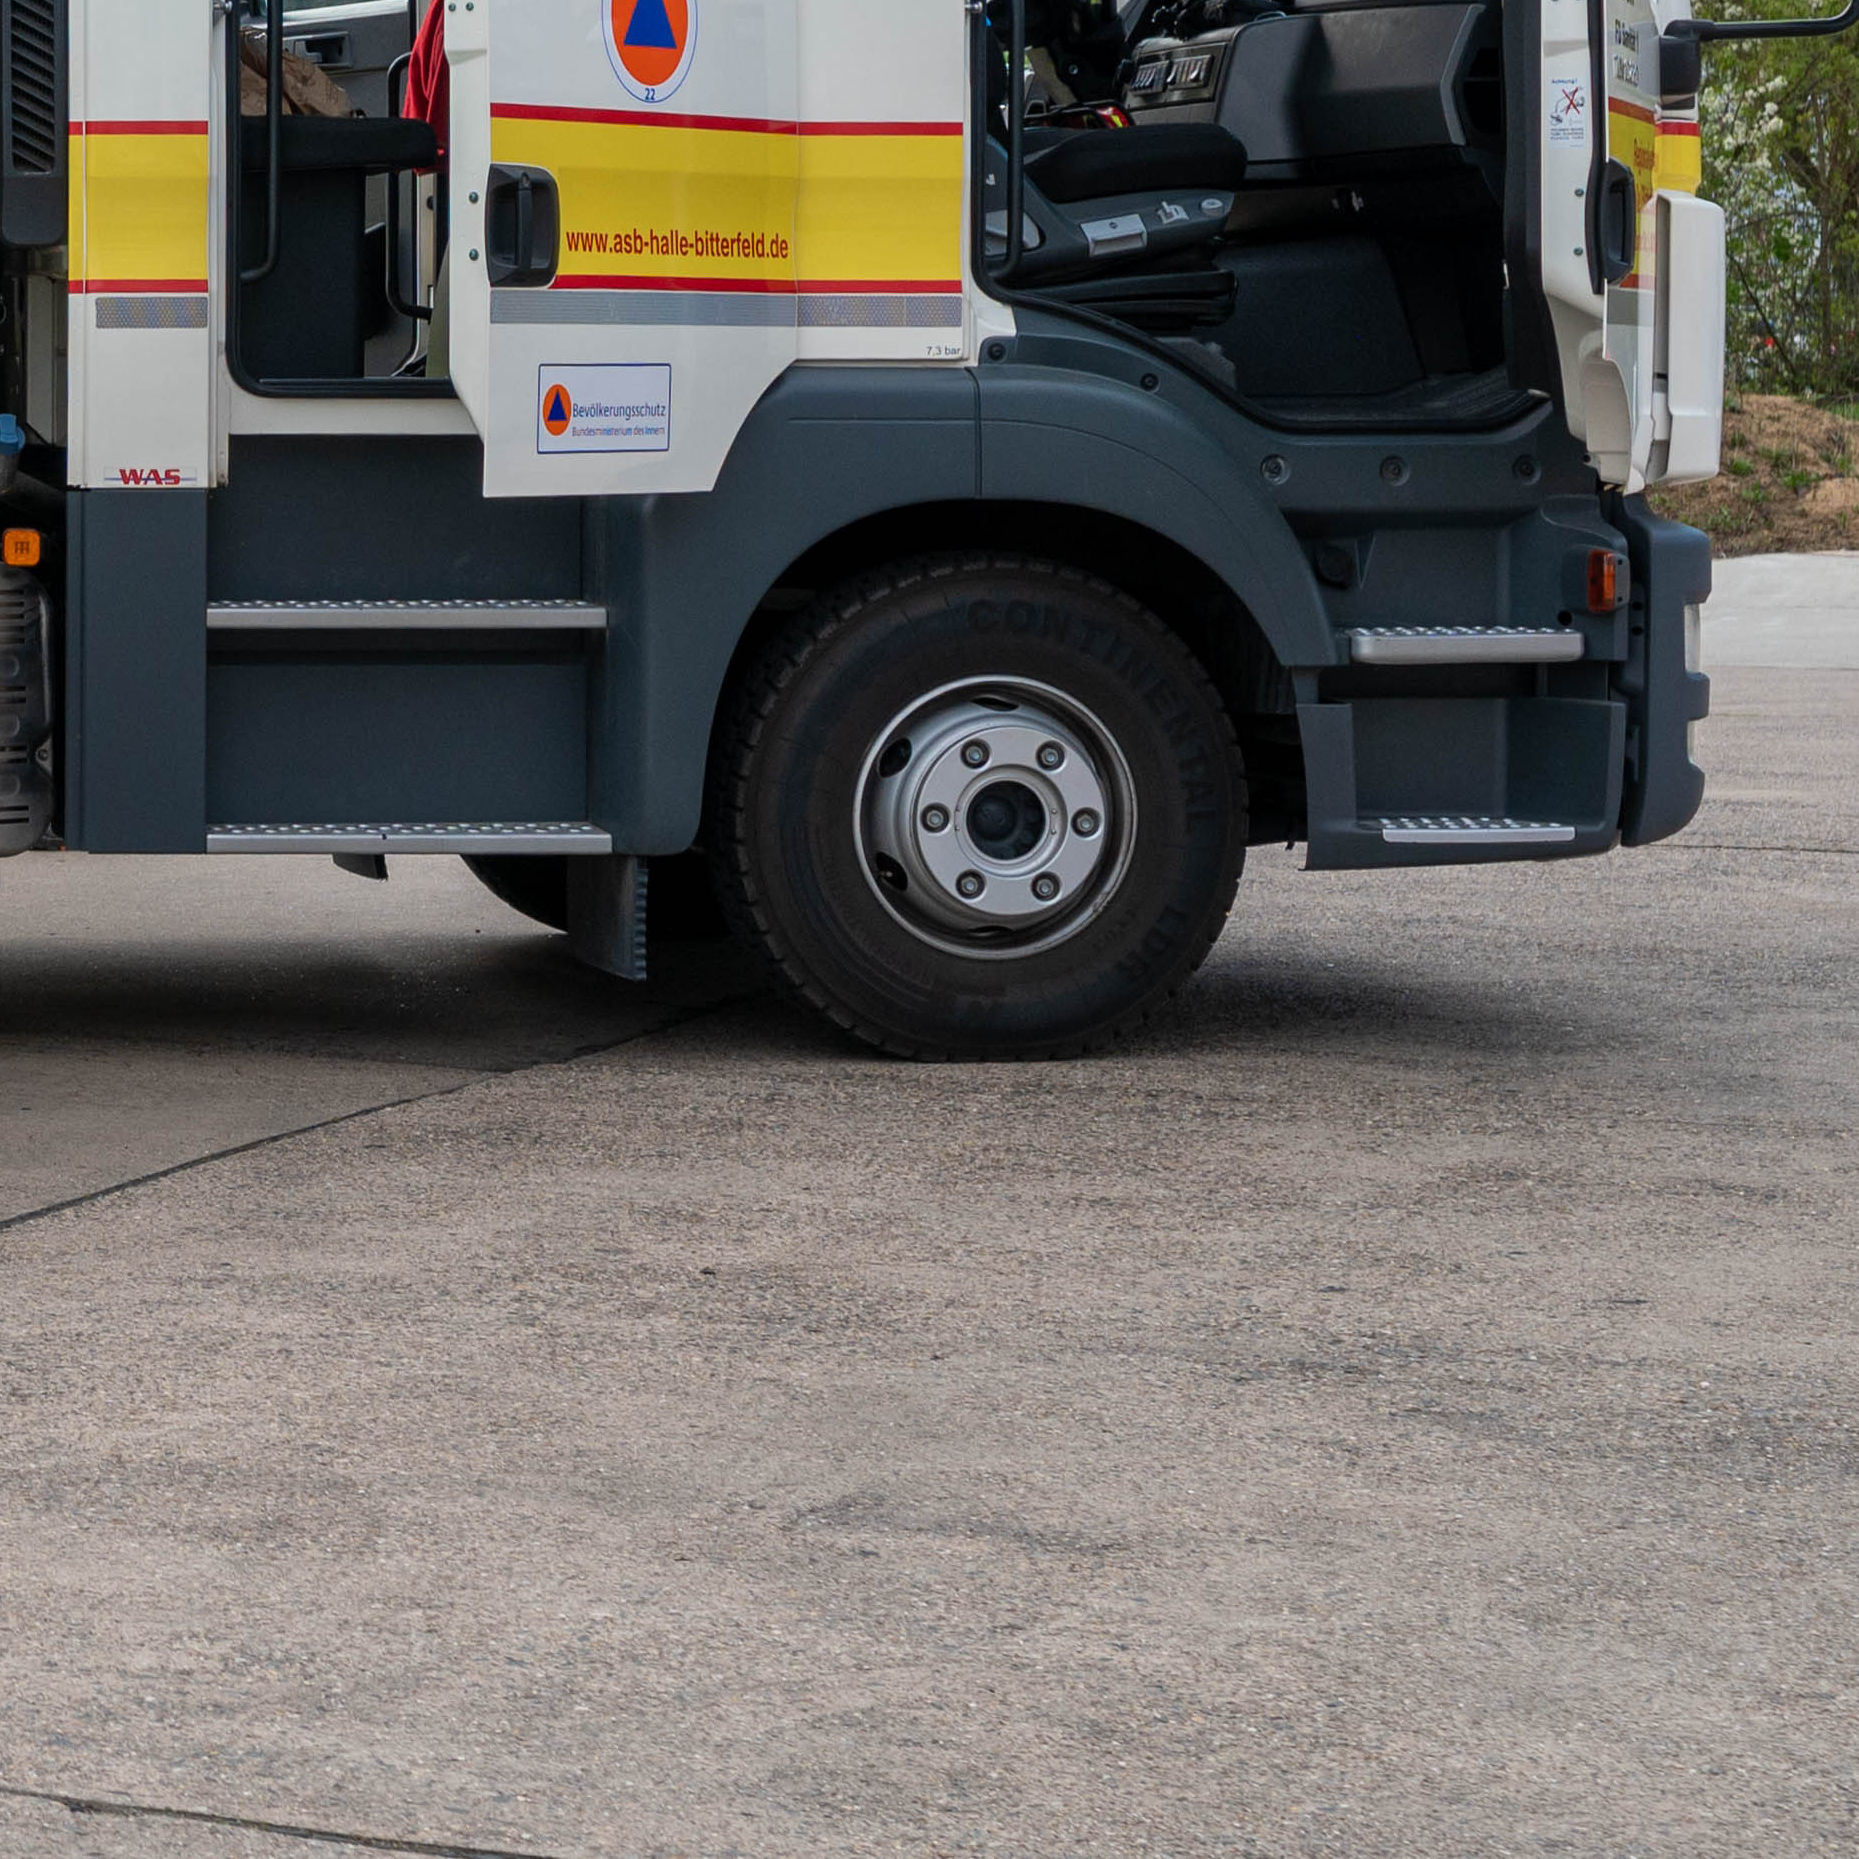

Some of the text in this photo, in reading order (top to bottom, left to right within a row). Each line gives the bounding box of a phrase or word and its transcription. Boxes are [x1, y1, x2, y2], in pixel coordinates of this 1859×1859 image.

[644, 87, 656, 101] 22
[566, 228, 789, 259] www.asb-halle-bitterfeld.de
[944, 345, 962, 355] bar
[572, 401, 666, 421] Bevölkerungsschutz
[119, 468, 181, 486] WAS
